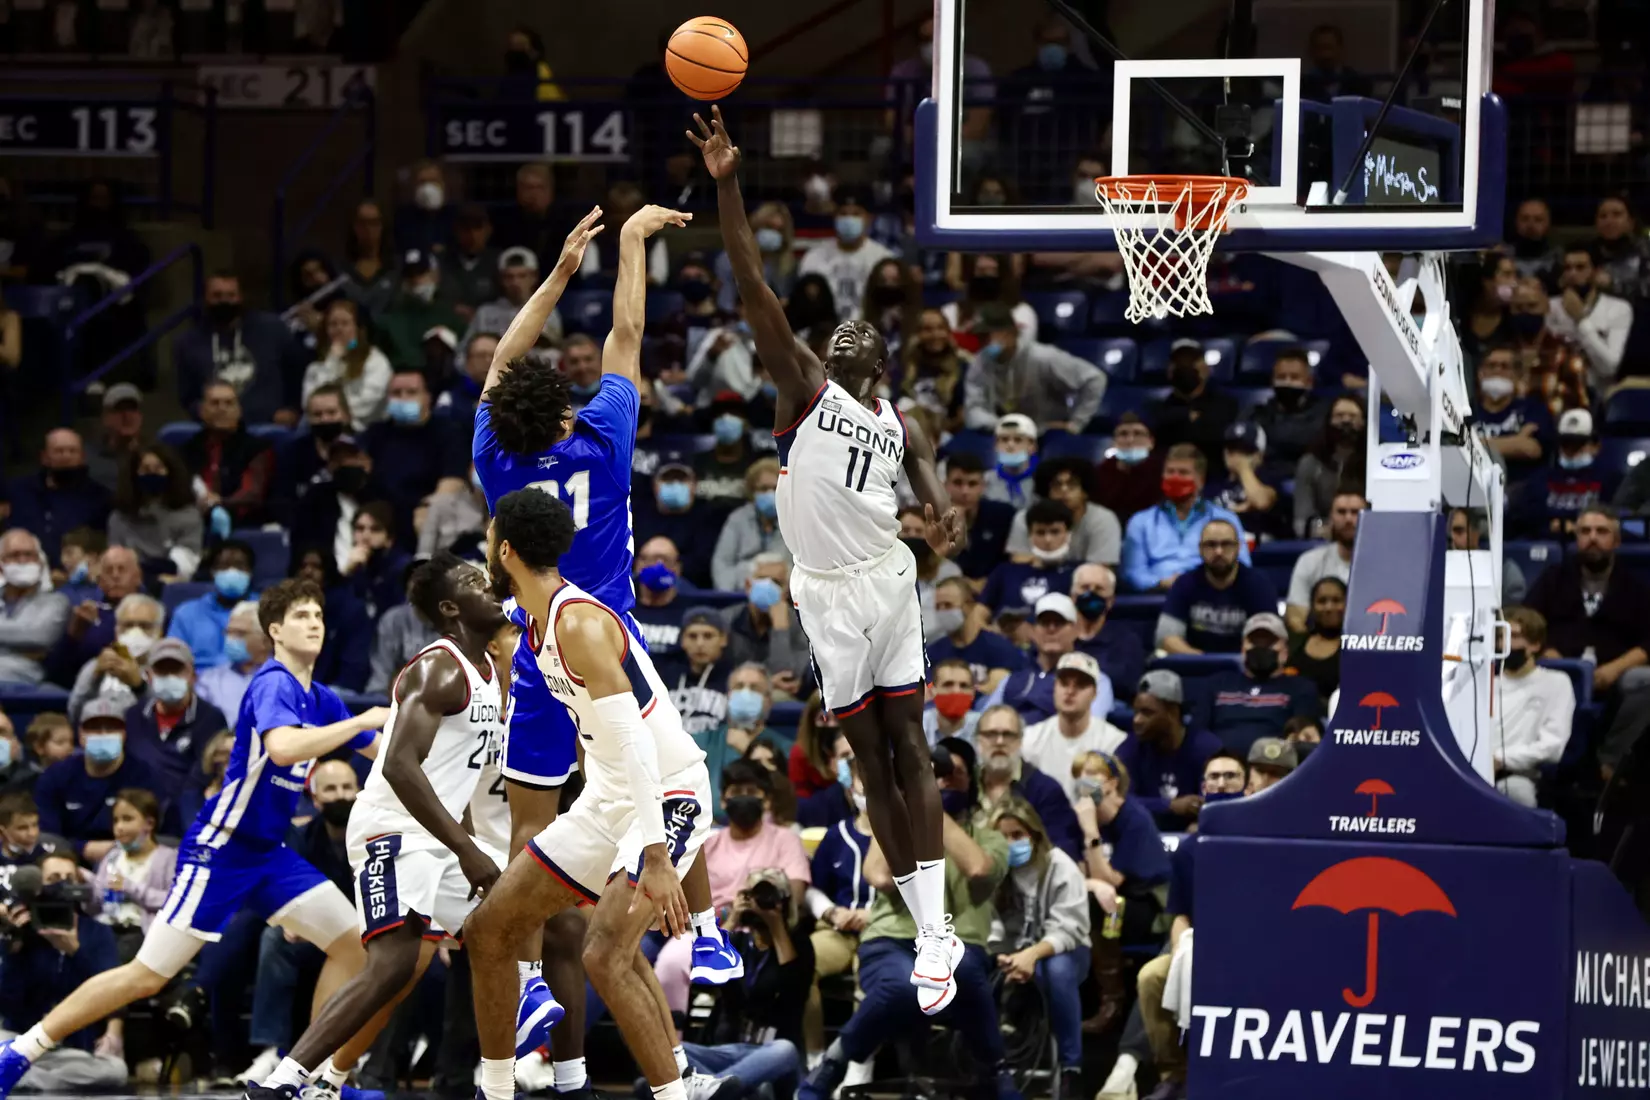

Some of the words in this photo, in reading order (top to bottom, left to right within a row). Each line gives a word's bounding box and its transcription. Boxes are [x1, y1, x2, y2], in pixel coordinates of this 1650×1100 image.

[0, 115, 38, 140] EC
[71, 107, 157, 152] 113
[445, 119, 508, 147] SEC
[535, 109, 628, 154] 114
[818, 411, 903, 462] UCONN
[845, 446, 873, 492] 11
[1340, 634, 1425, 652] TRAVELERS
[470, 705, 502, 723] UCON
[1333, 728, 1421, 747] TRAVELERS
[1328, 815, 1417, 834] TRAVELERS
[1191, 1005, 1541, 1074] TRAVELERS
[1577, 1037, 1650, 1089] JEWELE
